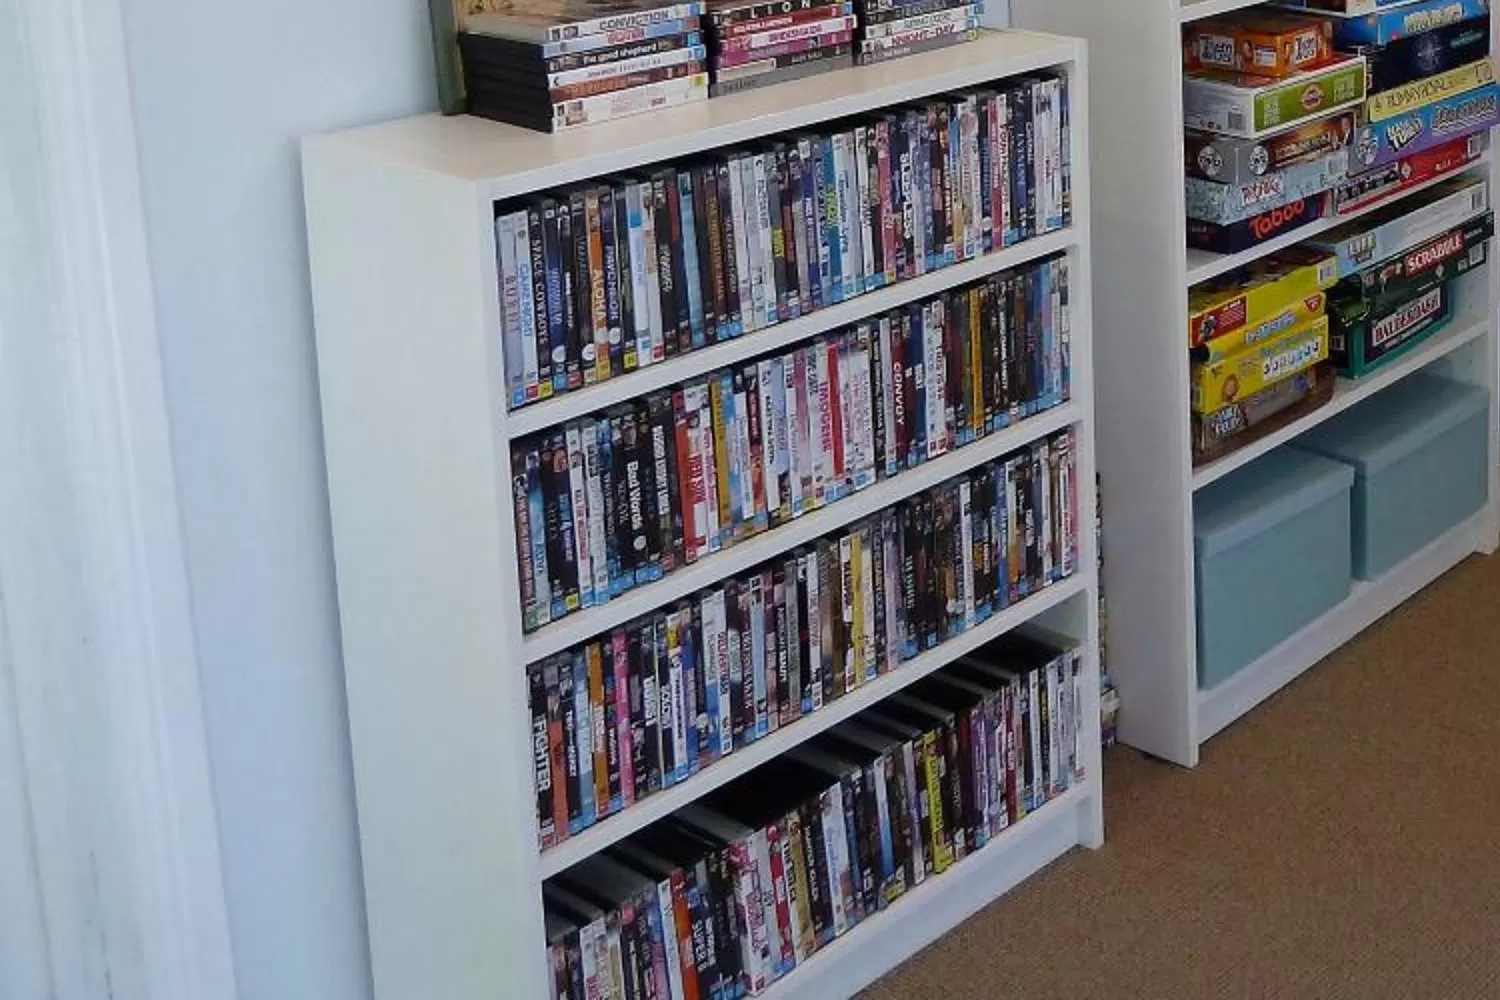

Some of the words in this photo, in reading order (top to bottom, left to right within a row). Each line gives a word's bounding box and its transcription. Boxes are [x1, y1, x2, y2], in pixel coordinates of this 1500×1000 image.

[600, 10, 670, 31] CONVICTION
[1250, 200, 1305, 238] Taboo
[1348, 231, 1377, 255] LIFE
[1406, 231, 1464, 274] SCRABBLE
[533, 282, 550, 344] COWBOYS
[591, 269, 607, 320] ALOHA
[891, 361, 905, 425] CONVOY
[626, 460, 641, 488] Bad
[628, 488, 645, 530] Words
[533, 719, 552, 792] FIGHTER
[691, 919, 708, 960] SUPER
